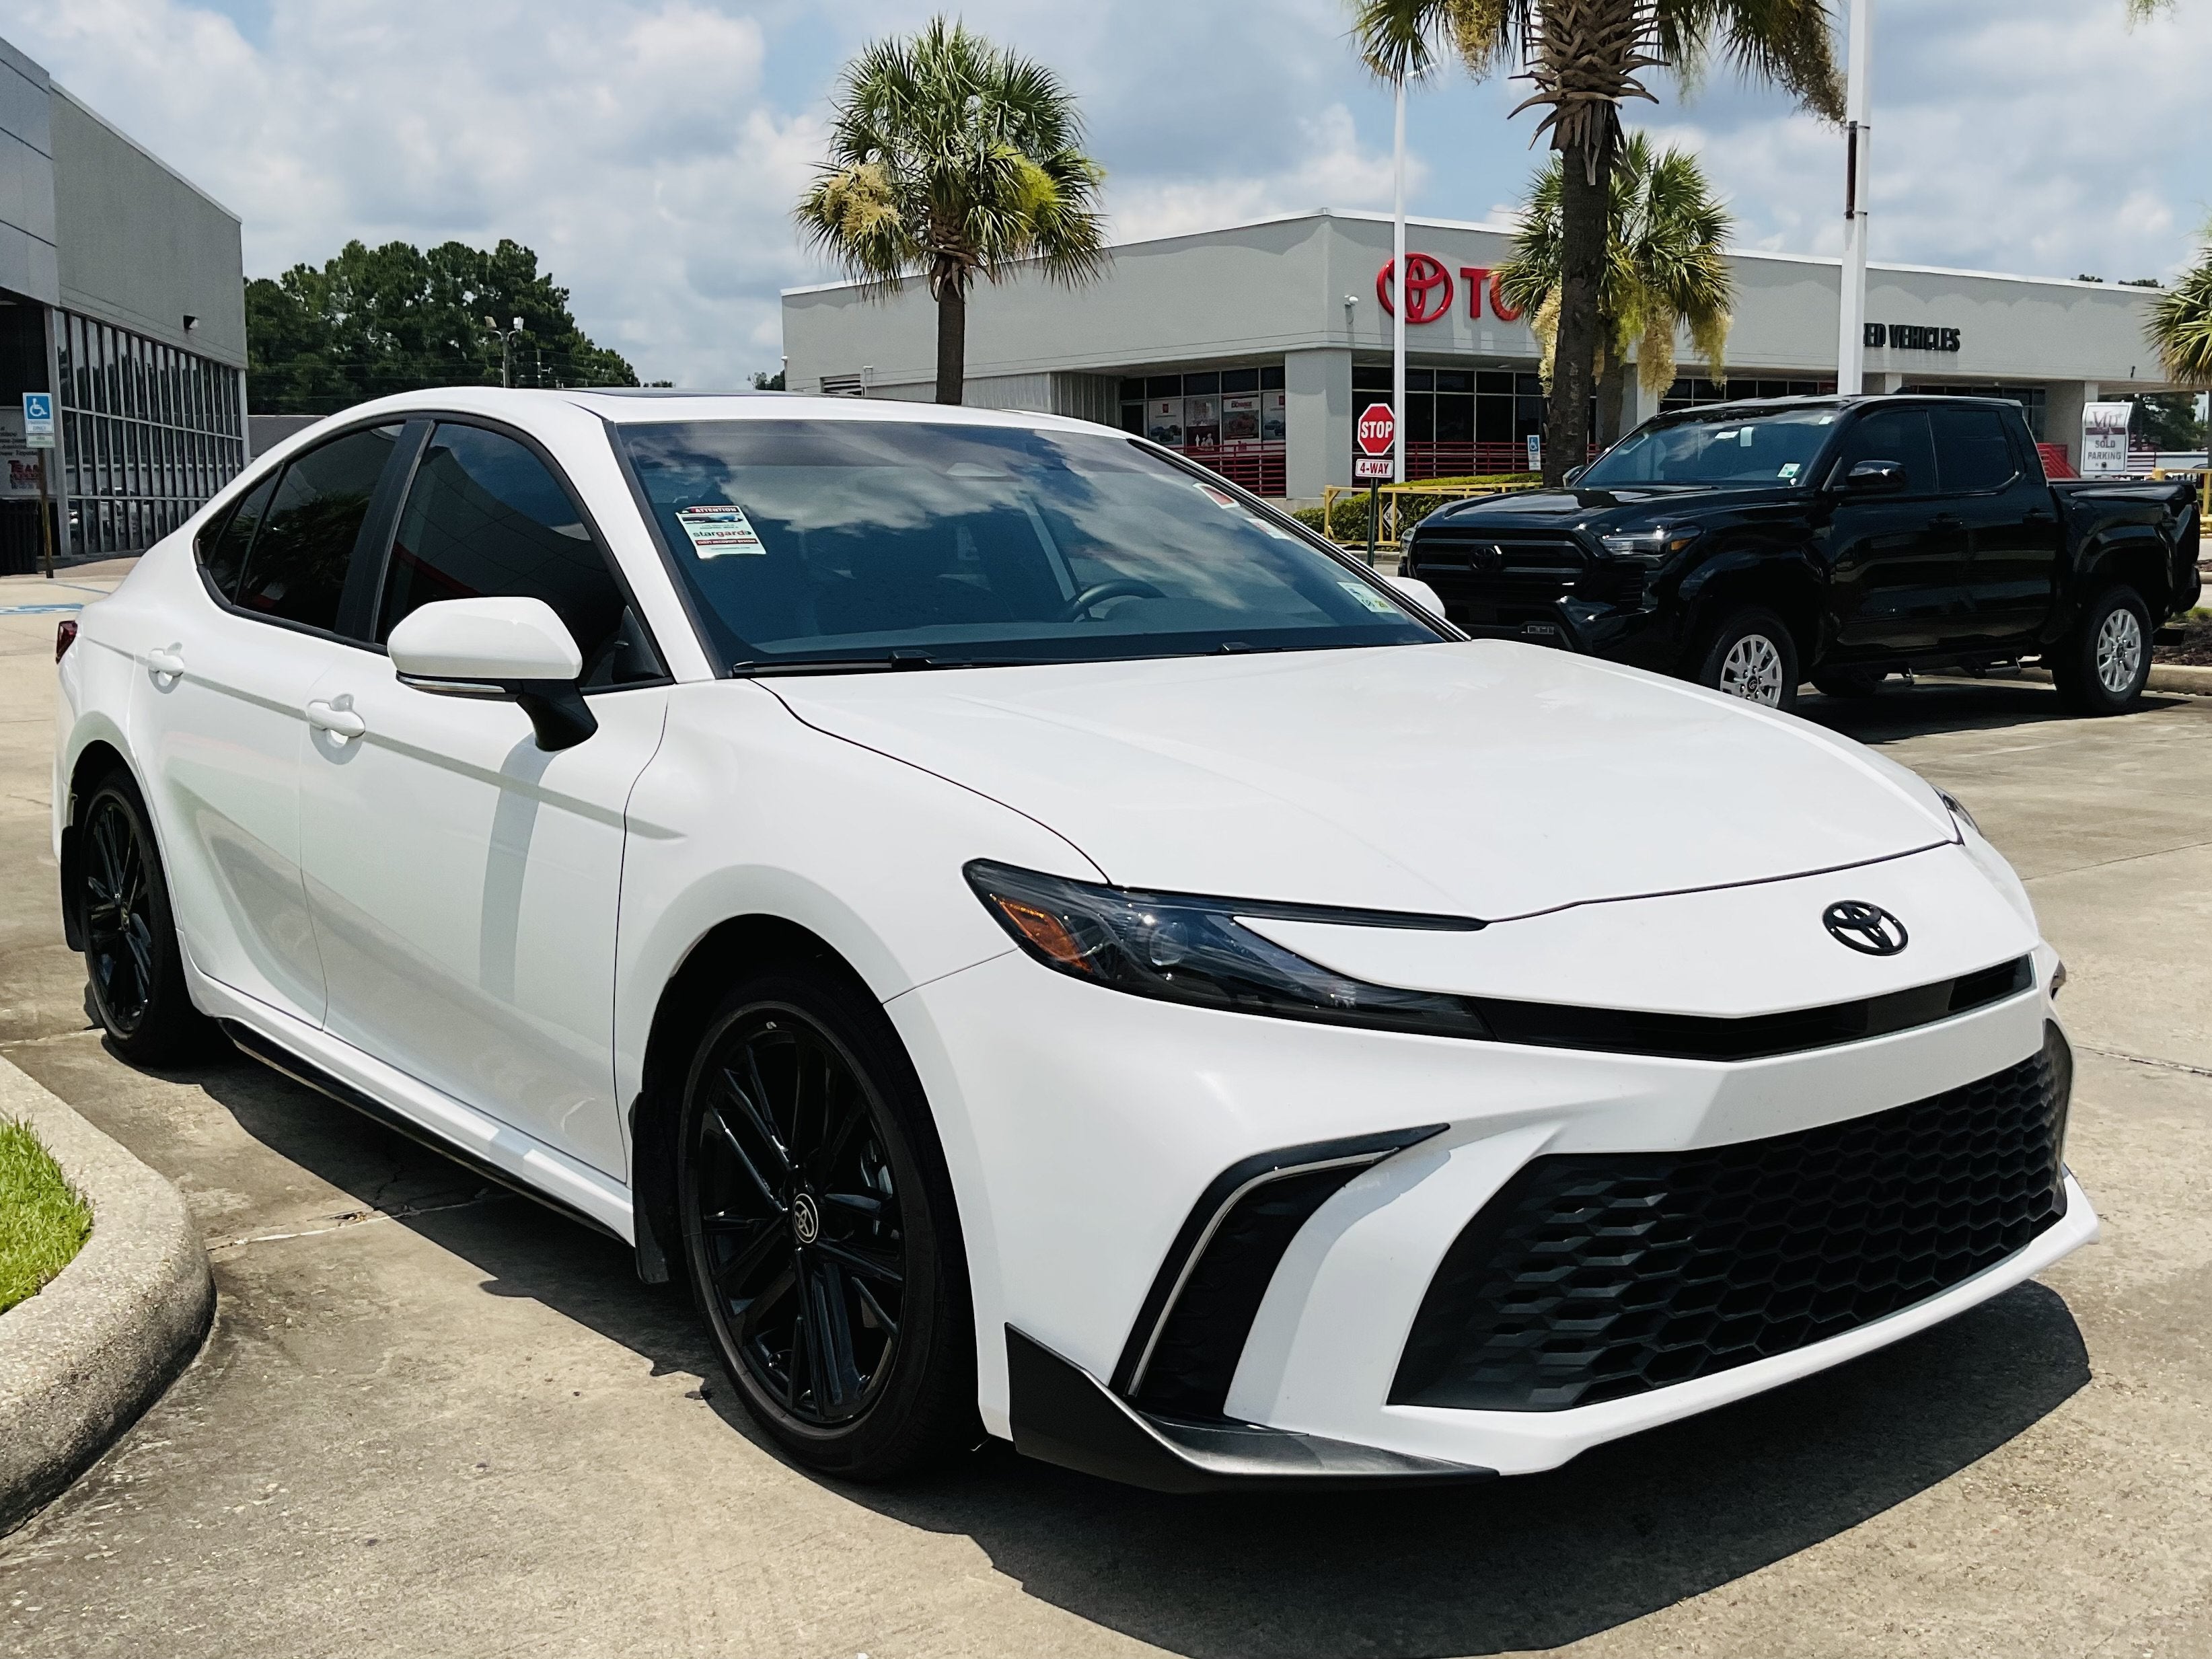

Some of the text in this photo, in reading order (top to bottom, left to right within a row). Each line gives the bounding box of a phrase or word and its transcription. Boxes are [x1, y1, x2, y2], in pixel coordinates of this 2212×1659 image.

[1864, 323, 1961, 352] ED VEHICLES
[1361, 421, 1393, 439] STOP
[2095, 440, 2116, 449] SOLD
[2088, 451, 2122, 460] PARKING
[1360, 462, 1389, 474] 4-WAY
[692, 529, 746, 538] stargard
